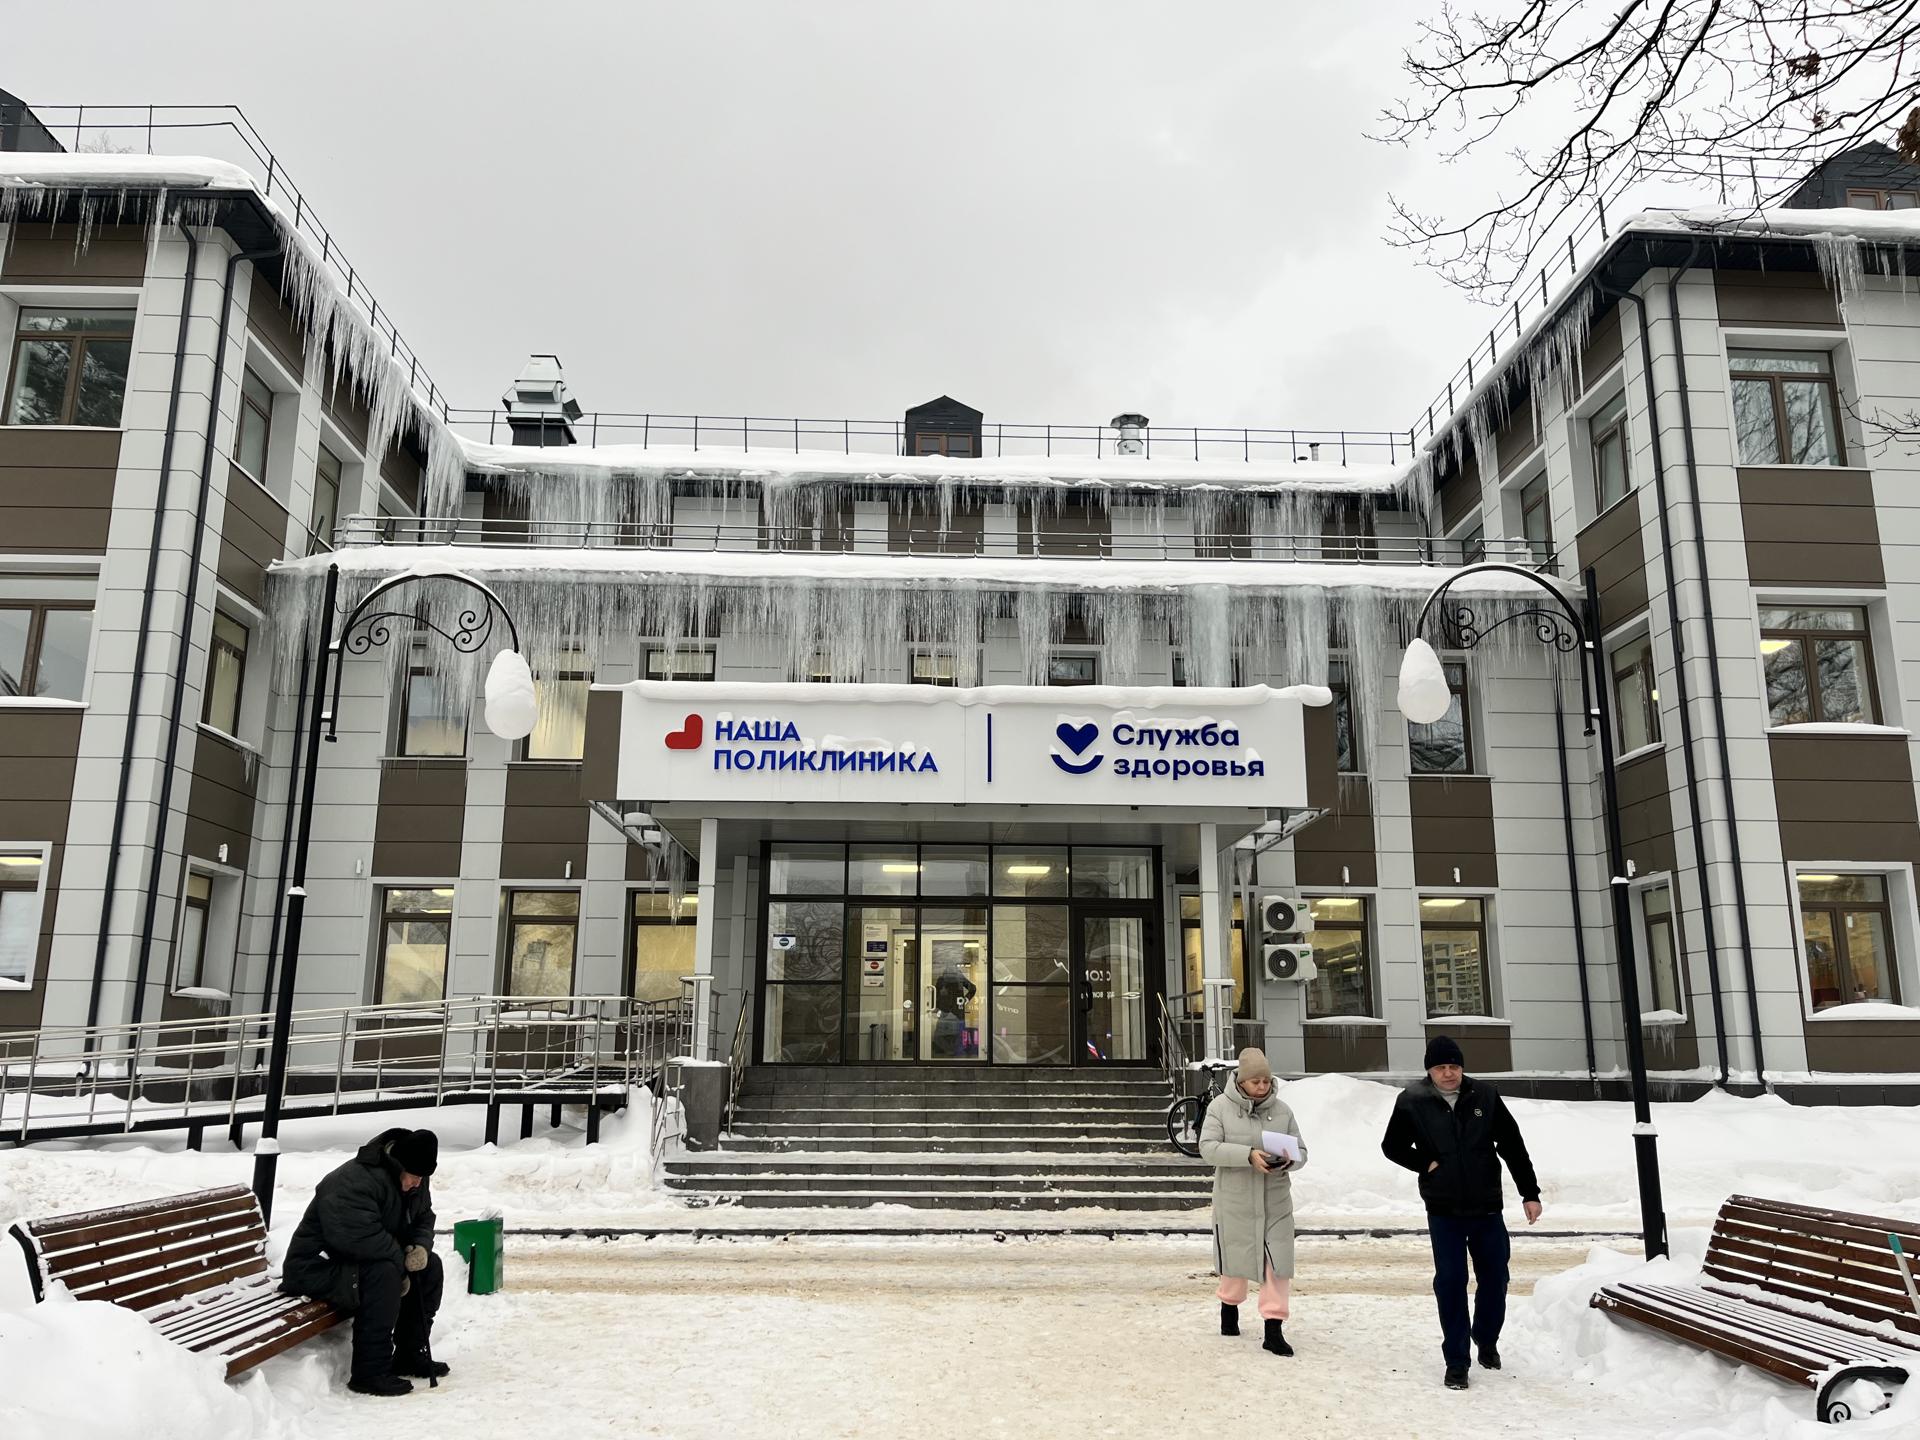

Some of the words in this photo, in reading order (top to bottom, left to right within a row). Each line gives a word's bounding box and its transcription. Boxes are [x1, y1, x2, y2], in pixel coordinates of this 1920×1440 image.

[715, 720, 801, 742] НАША
[1112, 722, 1240, 751] Служба
[713, 749, 939, 773] ПОЛИКЛИНИКА
[1113, 758, 1265, 781] здоровья
